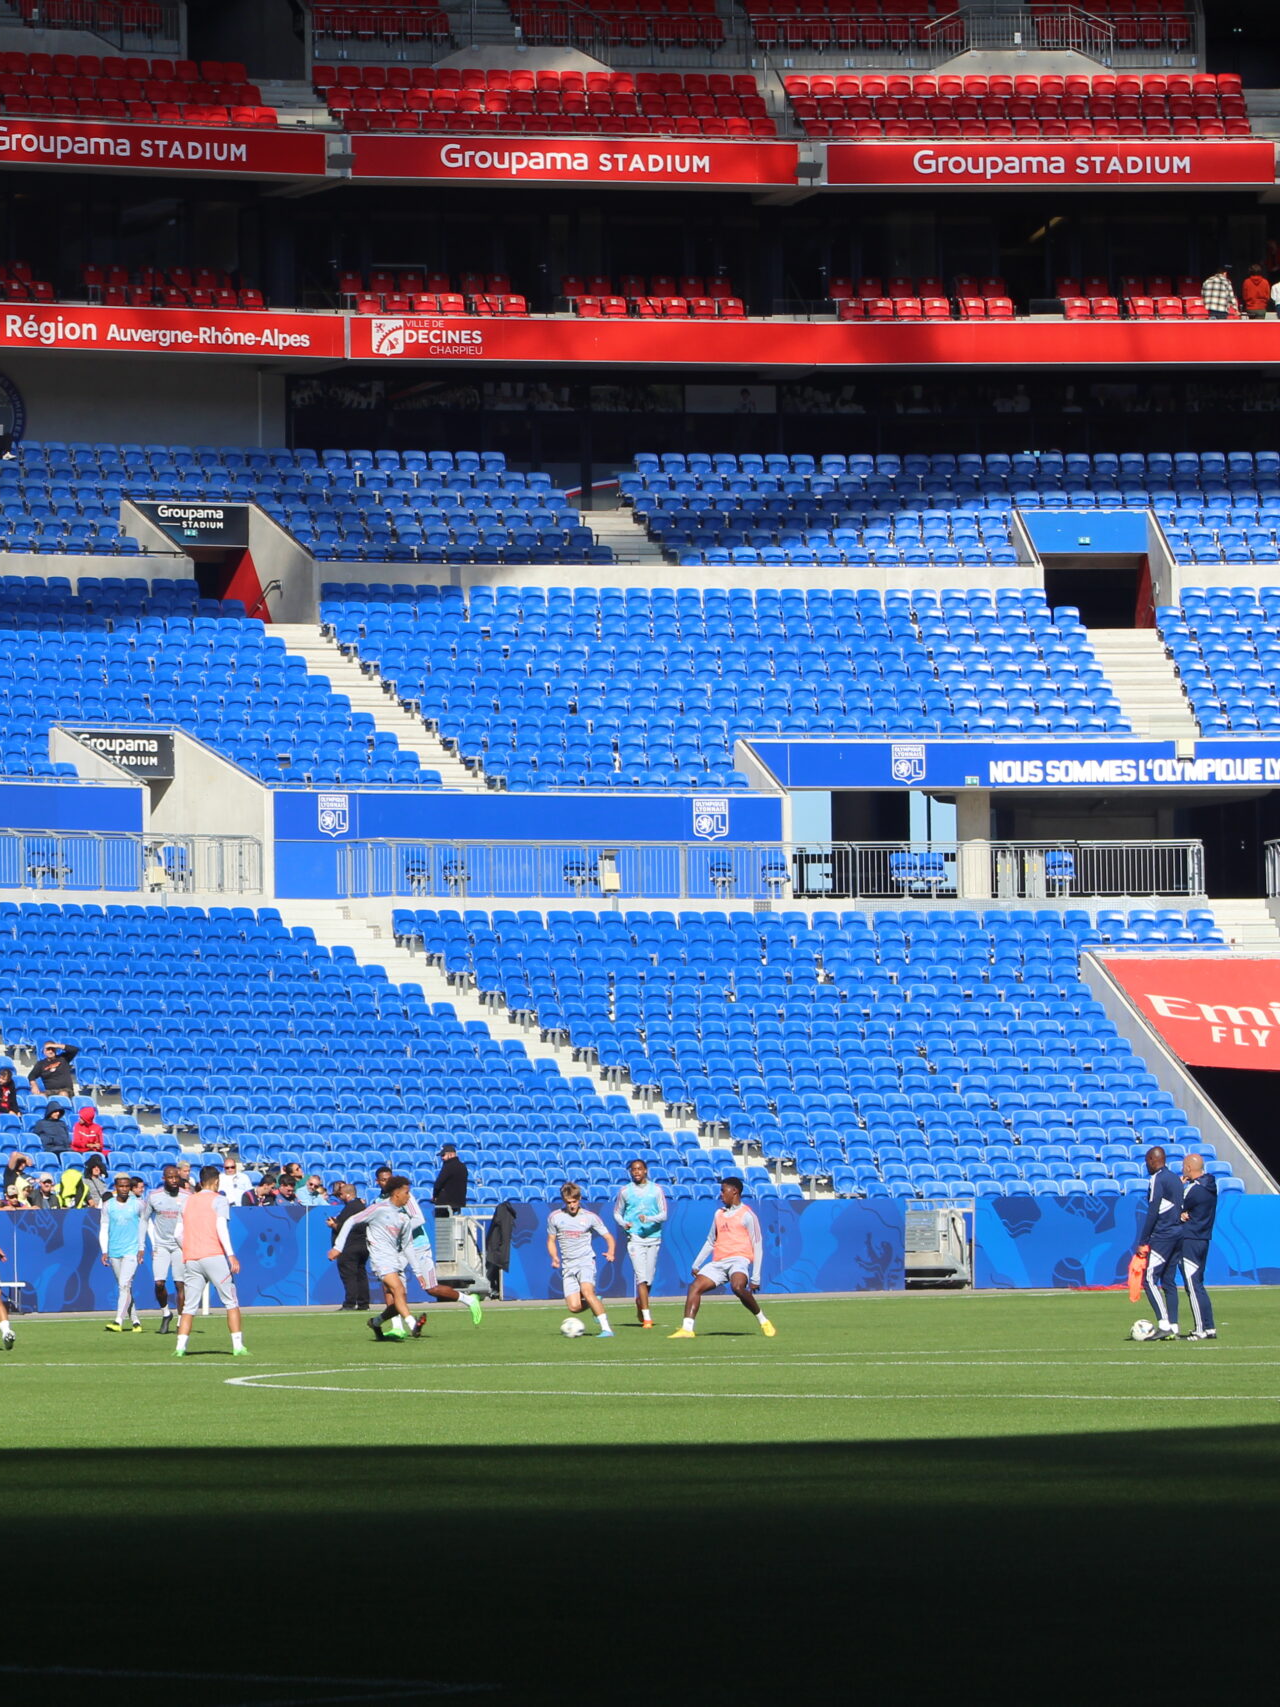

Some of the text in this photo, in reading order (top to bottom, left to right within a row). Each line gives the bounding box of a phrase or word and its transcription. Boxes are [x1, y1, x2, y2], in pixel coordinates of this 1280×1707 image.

[140, 139, 247, 161] STADIUM
[440, 143, 710, 174] Groupama STADIUM
[913, 149, 1191, 179] Groupama STADIUM
[4, 314, 98, 346] Région
[106, 323, 311, 349] Auvergne-Rhône-Alpes
[404, 319, 445, 328] VILLE DE
[404, 329, 483, 344] DECINES
[428, 345, 483, 355] CHARPIEU
[157, 505, 224, 520] Groupama
[181, 520, 224, 529] STADIUM
[989, 760, 1042, 783] NOUS
[1046, 760, 1137, 783] SOMMES
[1143, 993, 1280, 1027] Emi
[1211, 1026, 1271, 1047] FLY
